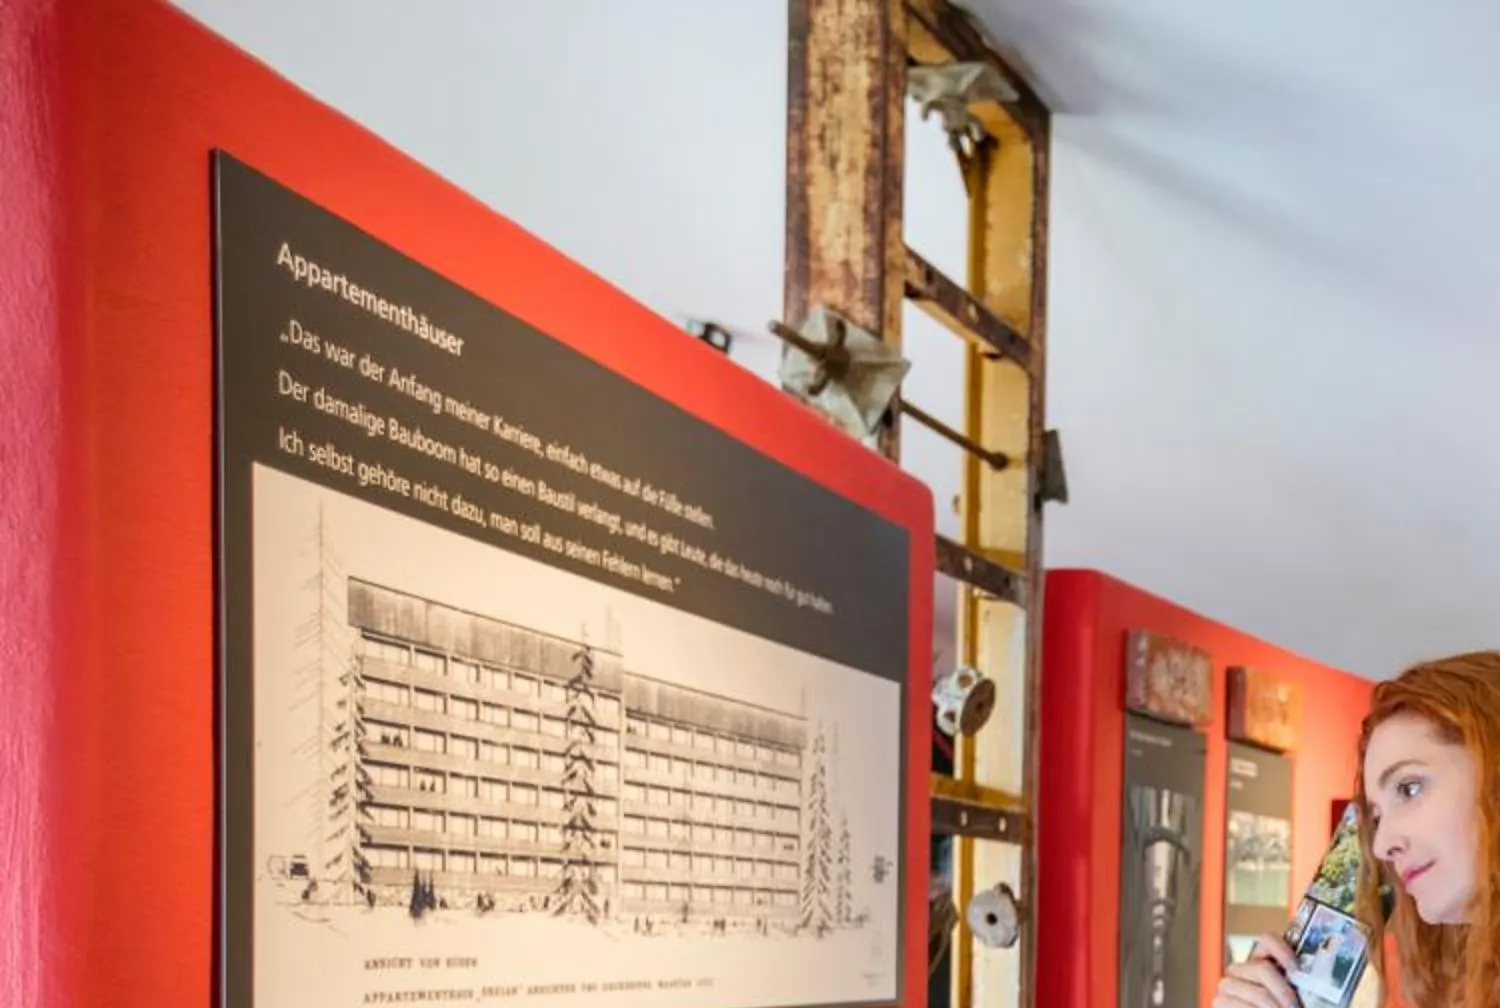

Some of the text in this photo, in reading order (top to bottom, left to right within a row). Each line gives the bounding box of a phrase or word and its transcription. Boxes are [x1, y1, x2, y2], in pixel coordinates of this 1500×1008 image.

[277, 242, 465, 357] Appartementhäuser
[278, 371, 309, 403] Der
[313, 389, 385, 437] damalige
[388, 418, 456, 462] Bauboom
[459, 448, 482, 476] hat
[484, 462, 499, 482] so
[501, 469, 536, 496] einen
[538, 480, 576, 513] Baustil
[324, 340, 354, 369] war
[359, 354, 385, 382] der
[388, 368, 442, 414] Anfang
[445, 397, 490, 431] meiner
[279, 426, 304, 456] Ich
[308, 441, 354, 477] selbst
[358, 461, 410, 498] gehöre
[414, 481, 448, 511] nicht
[452, 494, 487, 528] dazu,
[490, 512, 519, 537] man
[520, 523, 541, 544] soll
[543, 532, 564, 553] aus
[565, 540, 601, 567] seinen
